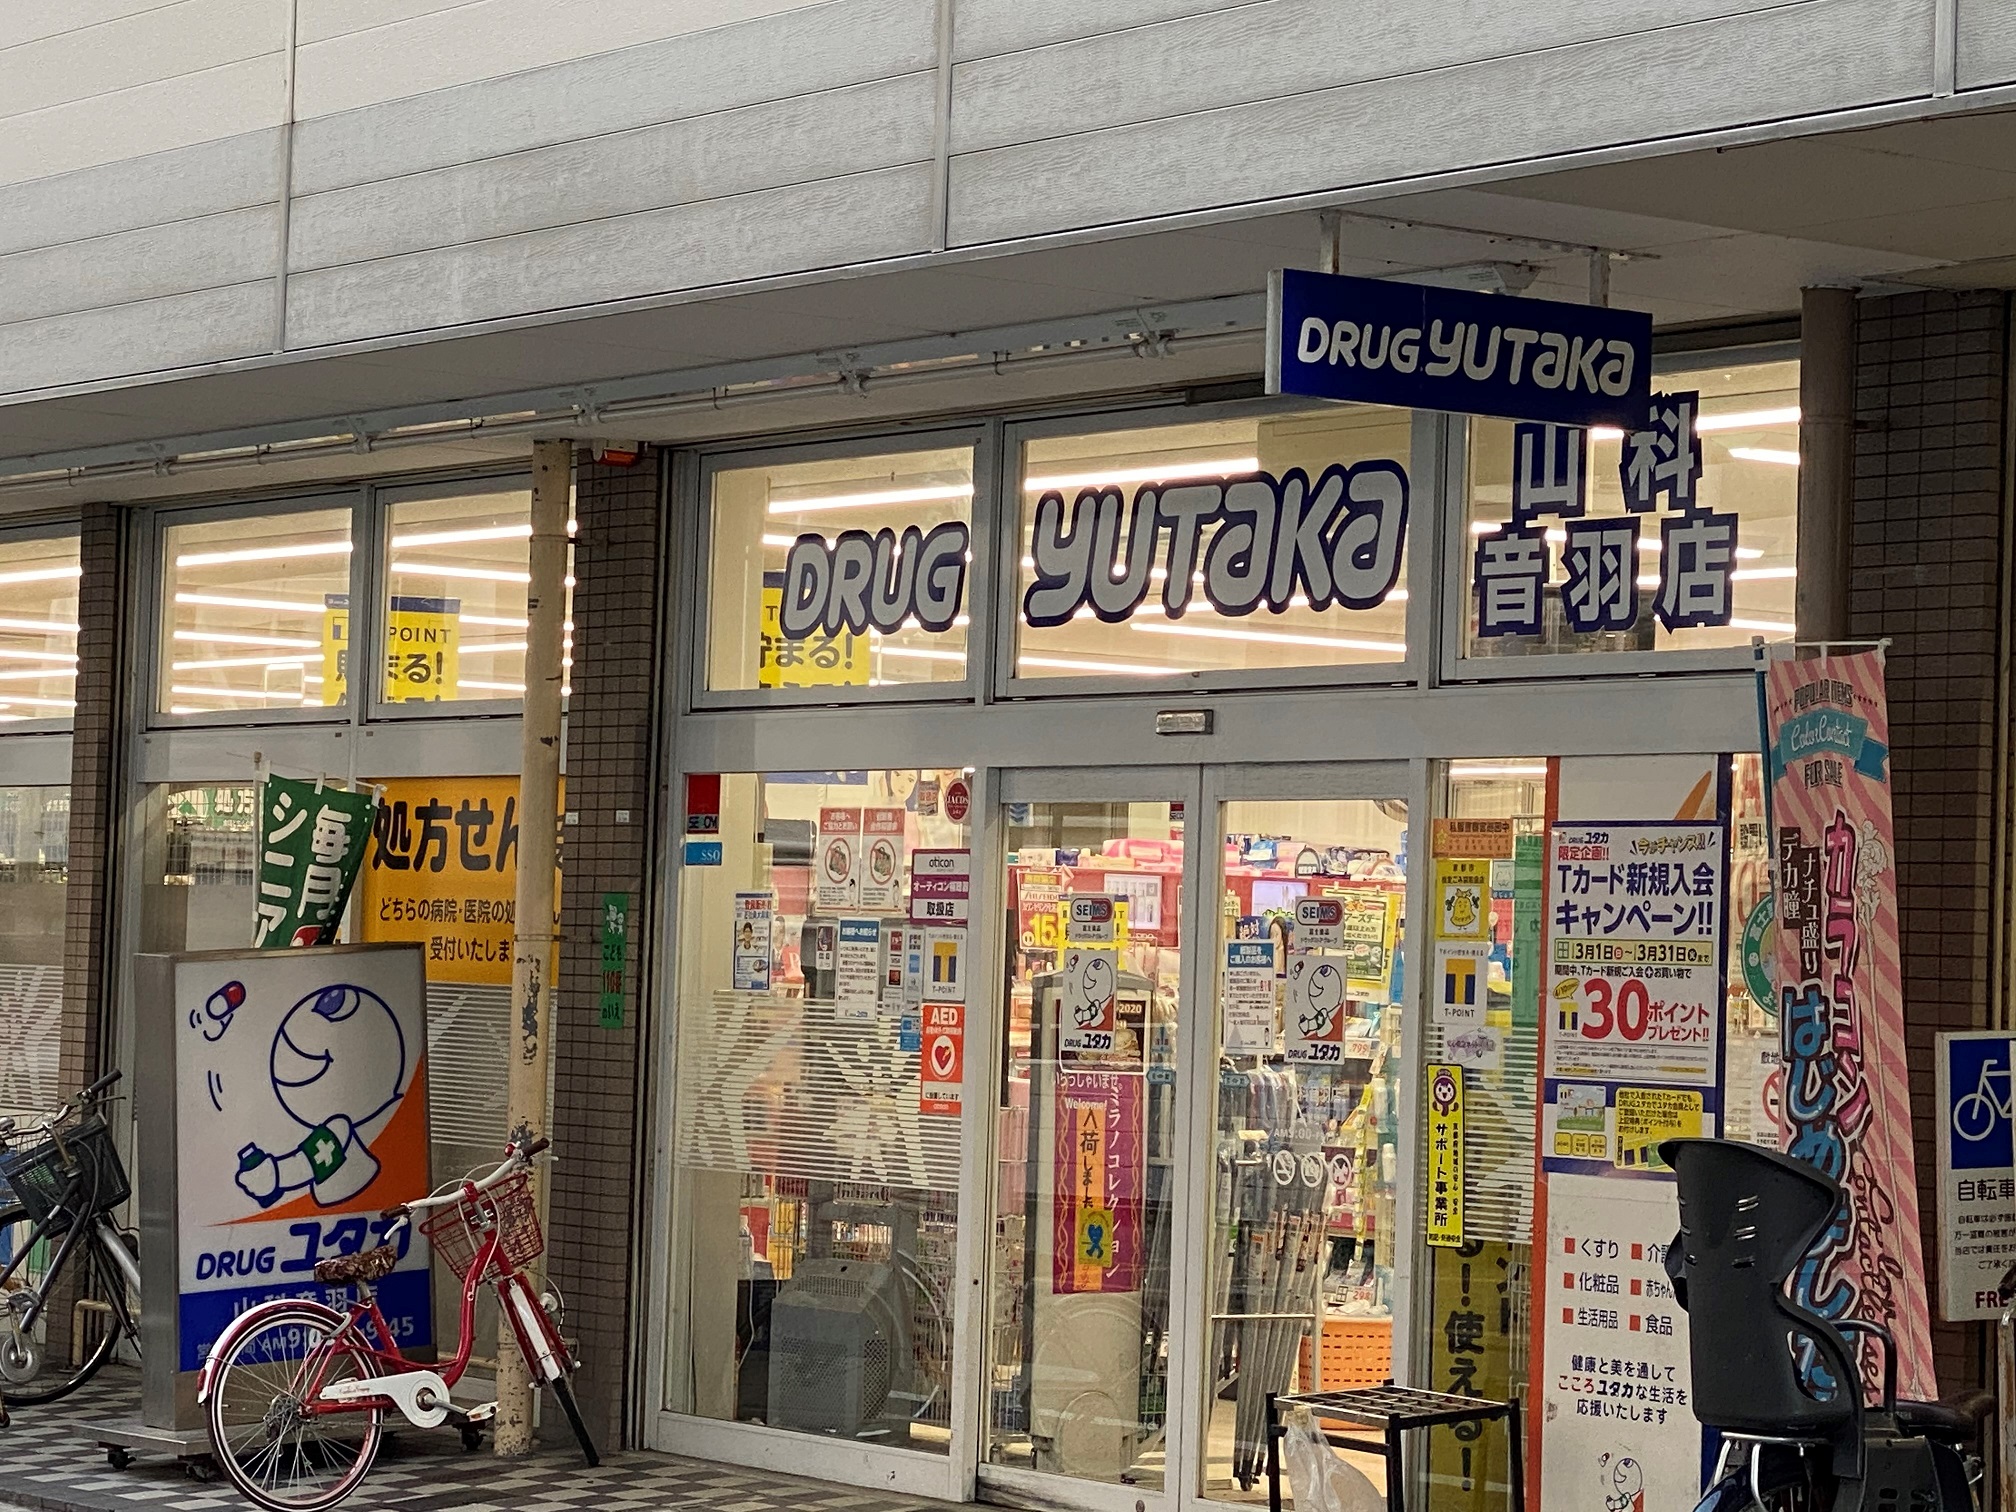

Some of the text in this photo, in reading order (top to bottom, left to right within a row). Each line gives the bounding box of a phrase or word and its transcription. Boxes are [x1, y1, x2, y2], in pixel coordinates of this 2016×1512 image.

[1297, 316, 1422, 374] DRUG
[1514, 390, 1703, 517] 山科
[781, 521, 969, 640] DRUG
[1474, 513, 1738, 638] 音羽店
[1584, 832, 1609, 844] ユタカ
[297, 804, 351, 921] 毎月
[929, 856, 955, 868] oticon
[1557, 862, 1715, 897] Tカード新規入会
[927, 902, 955, 916] 取扱店
[1076, 904, 1108, 917] SEIMS
[1302, 906, 1337, 918] SEIMS
[1345, 913, 1382, 923] アーズデー
[1556, 899, 1714, 936] キャンペーン!!
[1801, 852, 1821, 976] ナチュ盛り
[430, 937, 514, 962] 受付いたしま
[930, 1007, 959, 1026] AED
[1118, 1003, 1142, 1014] 2020
[1581, 977, 1650, 1042] 30
[1648, 1001, 1710, 1025] ポイント
[1064, 1033, 1112, 1050] DRUG ユタカ
[1648, 1026, 1710, 1043] プレゼント!!
[1288, 1043, 1341, 1061] DRUG ユタカ
[1065, 1097, 1107, 1111] Welcome!
[1106, 1088, 1122, 1279] ミラノコレクョン
[1434, 1123, 1448, 1227] サポート事業所
[1957, 1179, 2015, 1201] 自転車
[1581, 1238, 1620, 1260] くすり
[195, 1246, 276, 1280] DRUG
[1579, 1271, 1620, 1295] 化粧品
[1645, 1279, 1676, 1299] 赤ちゃん
[1577, 1306, 1619, 1330] 生活用品
[1645, 1313, 1674, 1337] 食品
[1571, 1354, 1677, 1383] 健康と美を通して
[1557, 1374, 1689, 1407] こころユタカな生活を
[1576, 1398, 1669, 1426] 応援いたします
